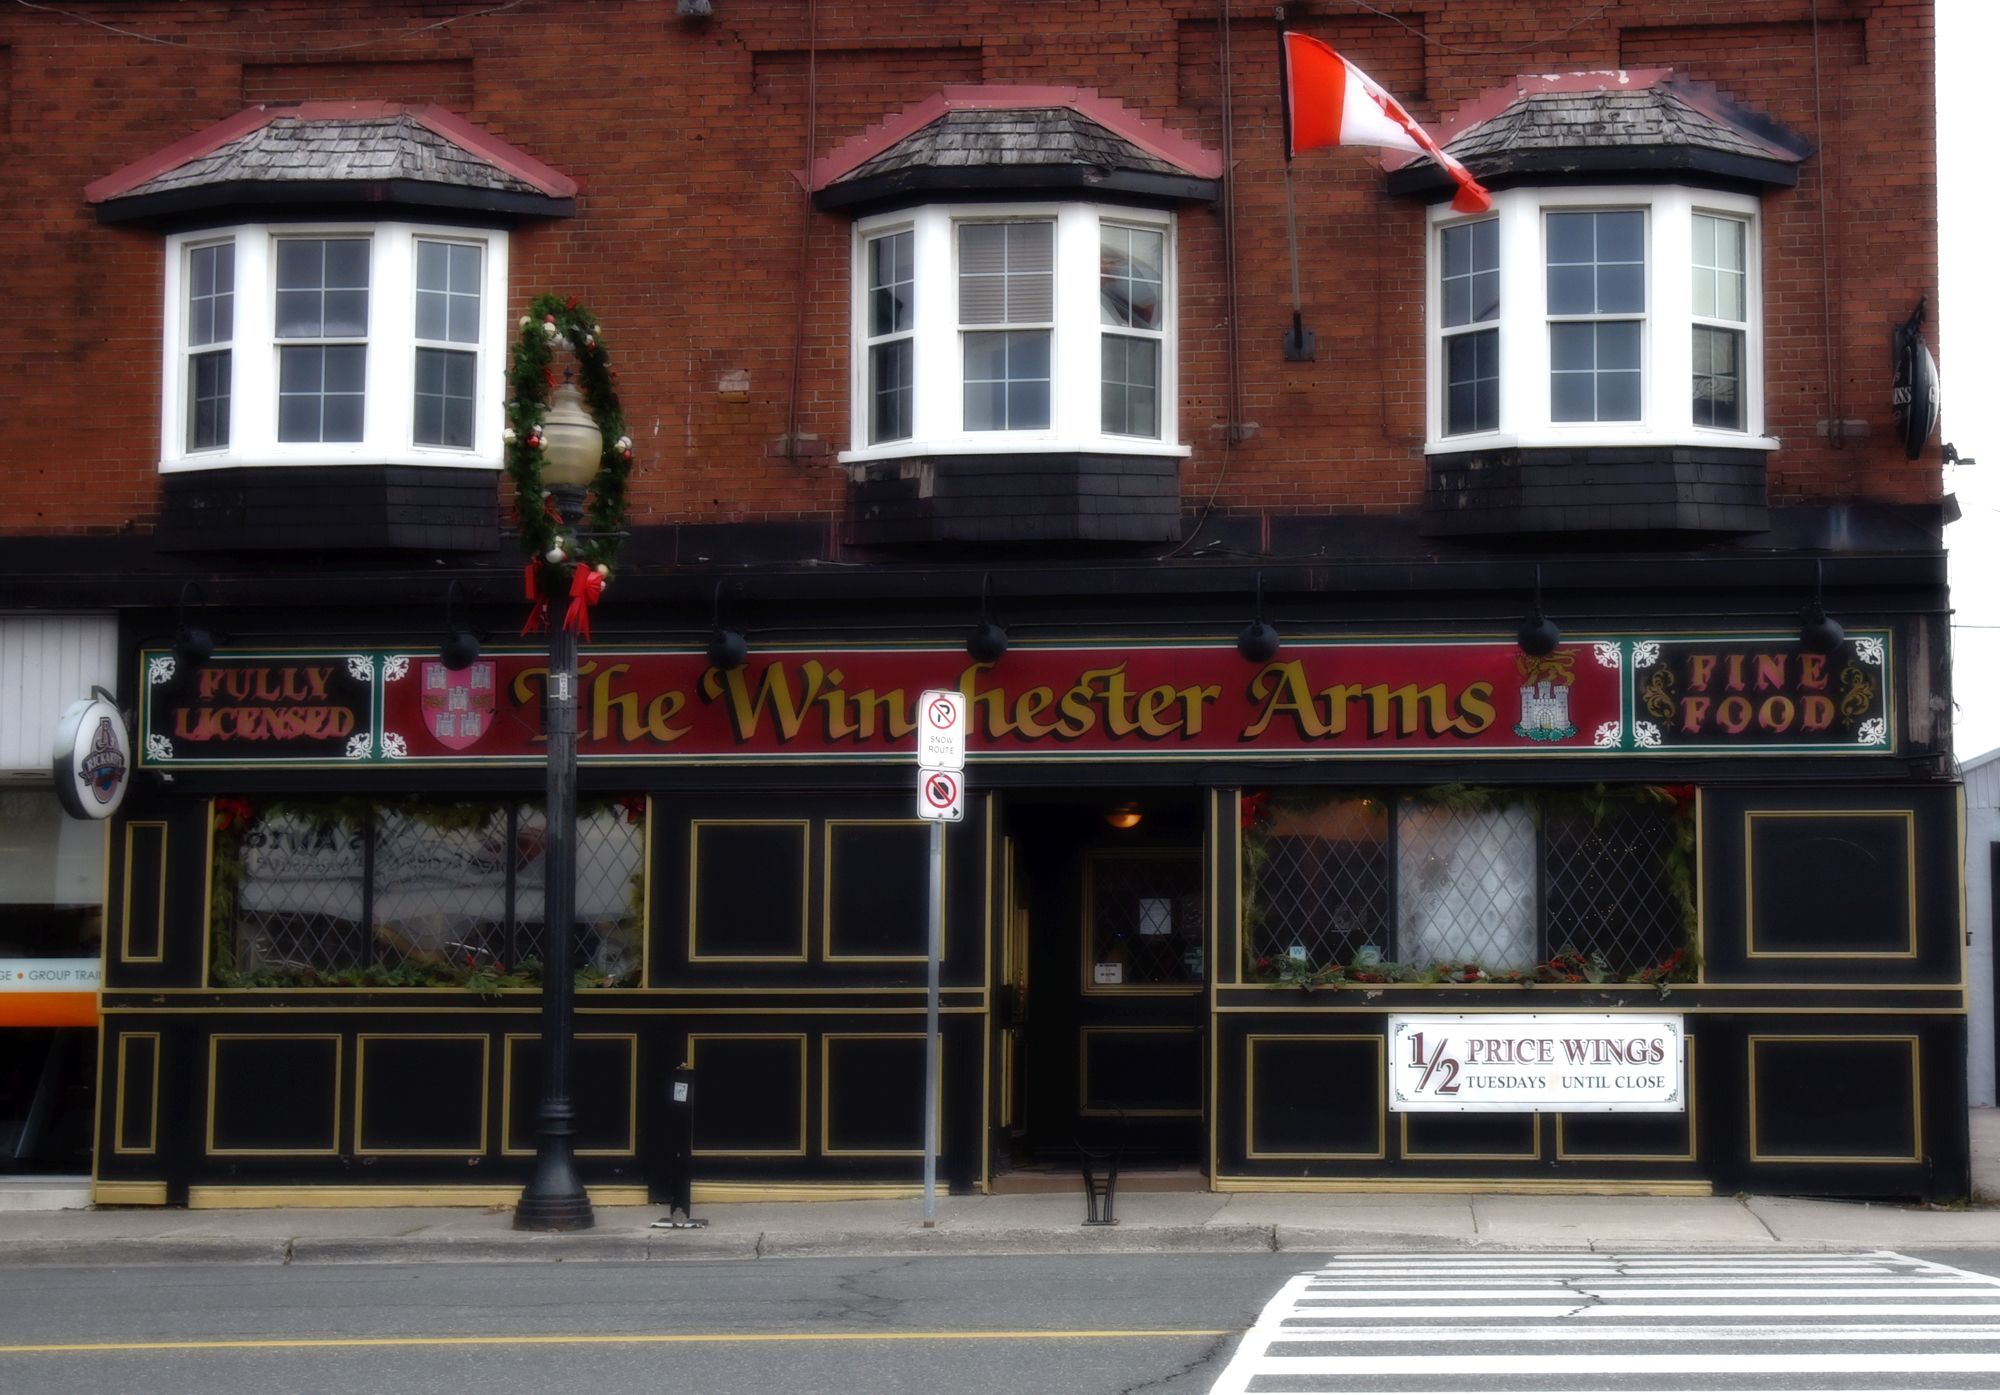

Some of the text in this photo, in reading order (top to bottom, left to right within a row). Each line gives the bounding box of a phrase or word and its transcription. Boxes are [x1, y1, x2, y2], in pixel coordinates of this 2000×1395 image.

[199, 667, 334, 701] FULLY
[1687, 654, 1829, 692] FINE
[702, 660, 1222, 741] Winhester
[1243, 659, 1496, 738] Arms
[1680, 695, 1834, 734] FOOD
[174, 706, 355, 741] LICENSED
[929, 745, 955, 755] ROUTE
[930, 735, 953, 744] SNOW
[29, 970, 71, 981] GROUP
[1465, 1039, 1555, 1065] PRICE
[1560, 1038, 1665, 1065] WINGS
[1465, 1075, 1665, 1089] TUESDAYS UNTIL CLOSE
